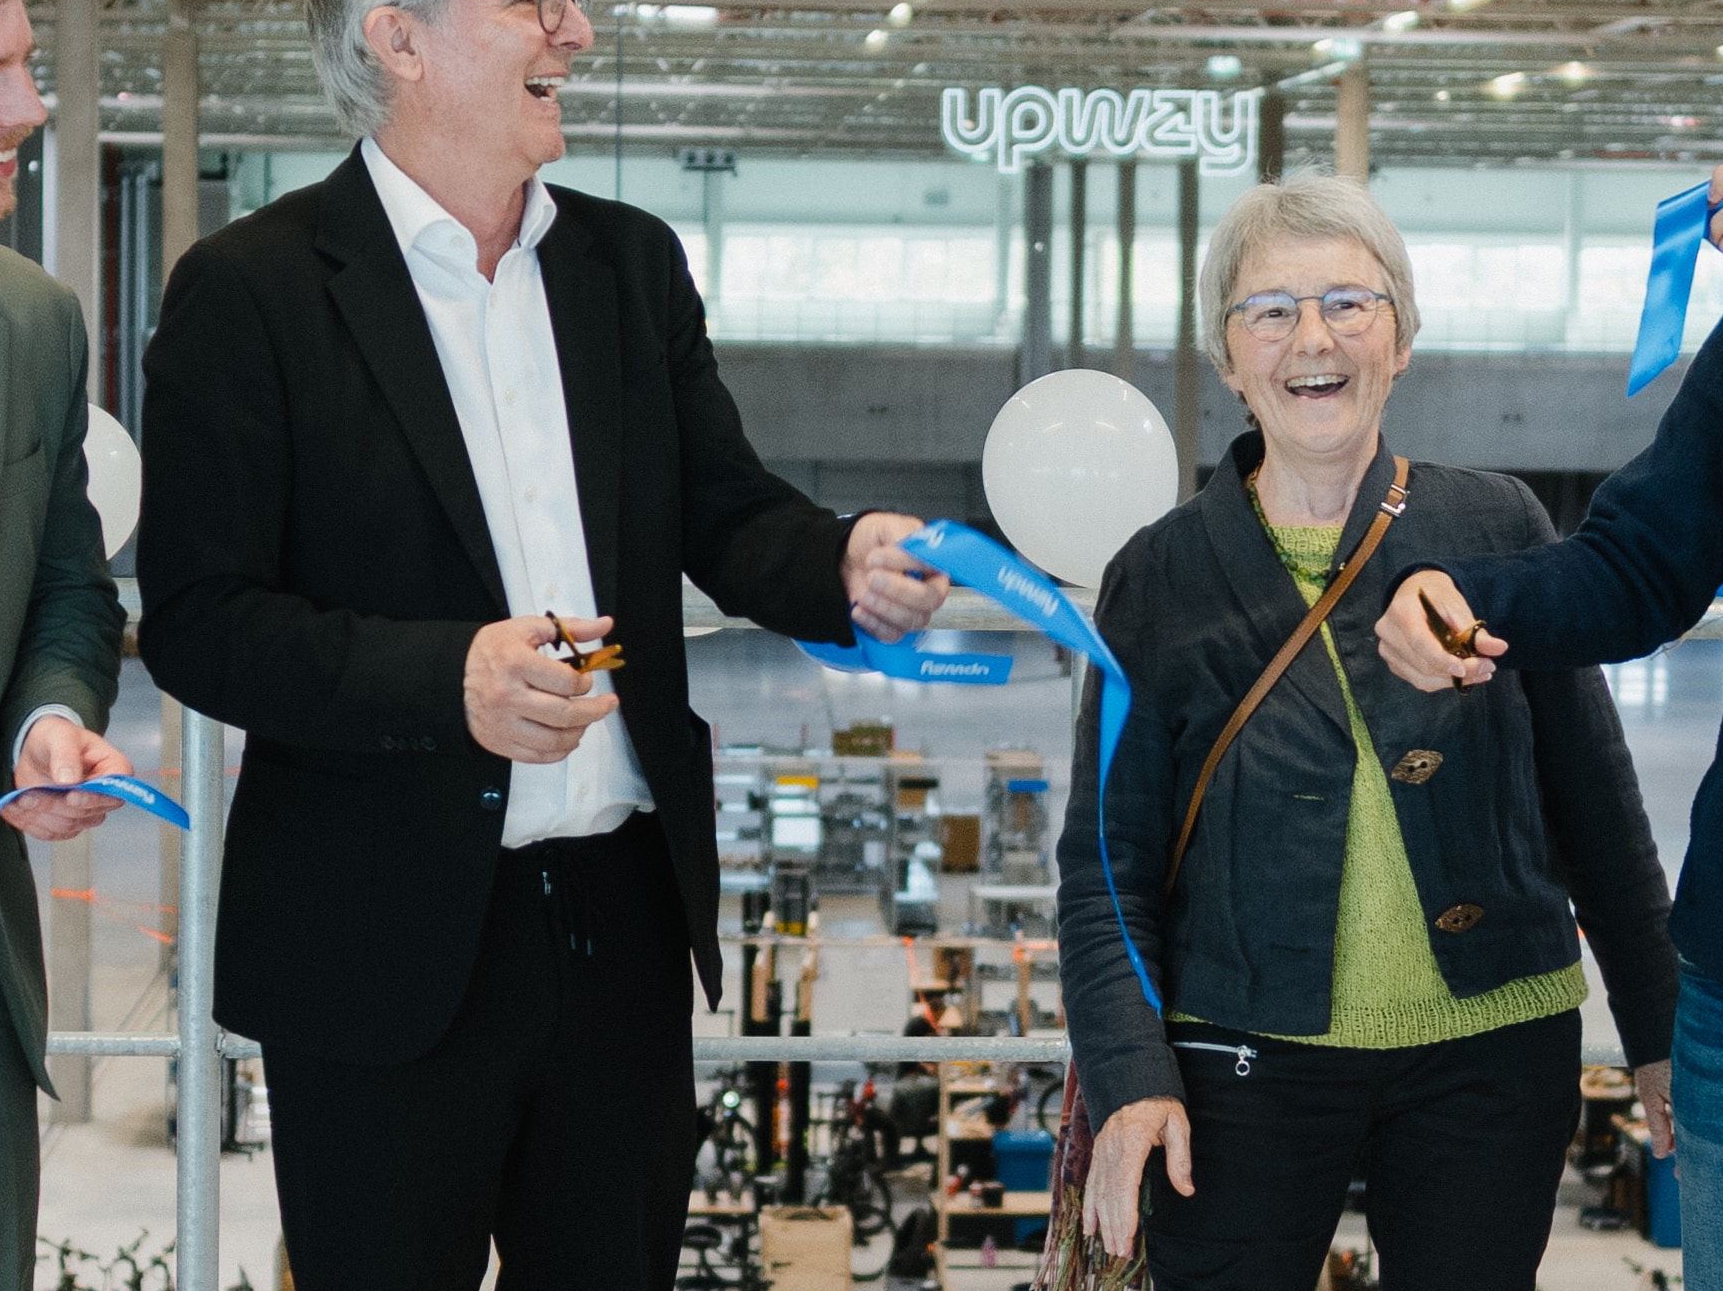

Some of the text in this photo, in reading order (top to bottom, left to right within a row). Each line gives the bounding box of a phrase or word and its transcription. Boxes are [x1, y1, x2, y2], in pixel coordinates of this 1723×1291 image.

[942, 84, 1254, 177] upway
[997, 566, 1060, 617] upway
[920, 660, 990, 676] upway
